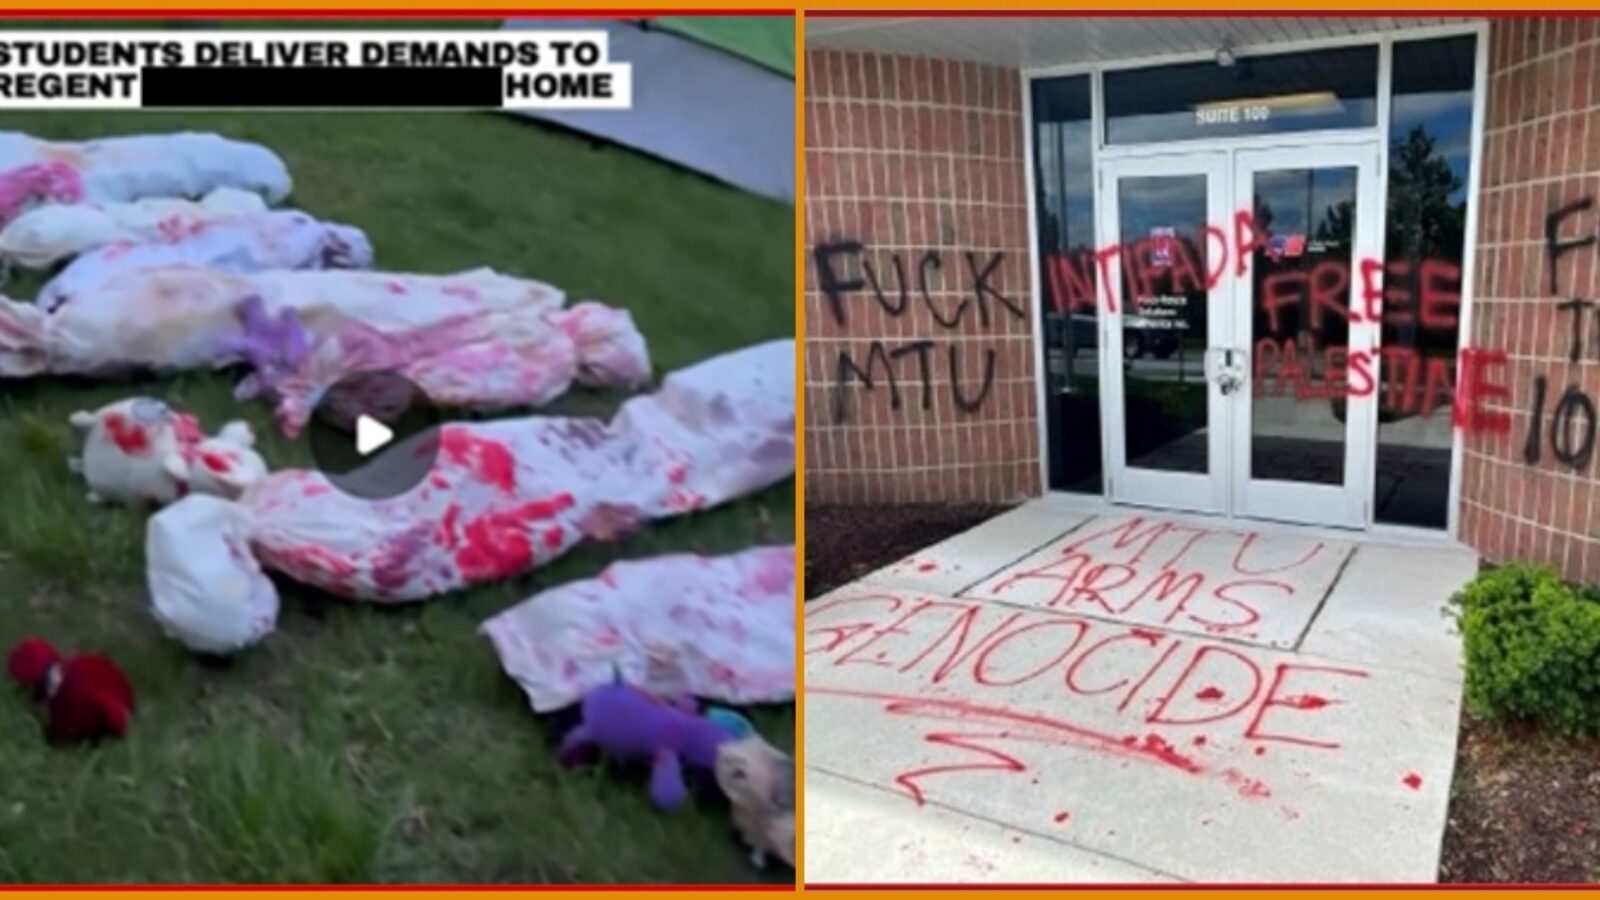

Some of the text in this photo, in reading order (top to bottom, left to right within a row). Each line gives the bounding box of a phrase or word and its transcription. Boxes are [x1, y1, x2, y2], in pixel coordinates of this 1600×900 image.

[1196, 105, 1270, 125] SUITE 100
[814, 240, 1025, 328] FUCK
[1263, 258, 1461, 332] FREE
[834, 341, 995, 424] MTU
[1252, 337, 1512, 435] PALESTINE
[1062, 516, 1324, 575] MTU
[993, 553, 1295, 628] ARMS
[804, 594, 1368, 749] GENOCIDE
